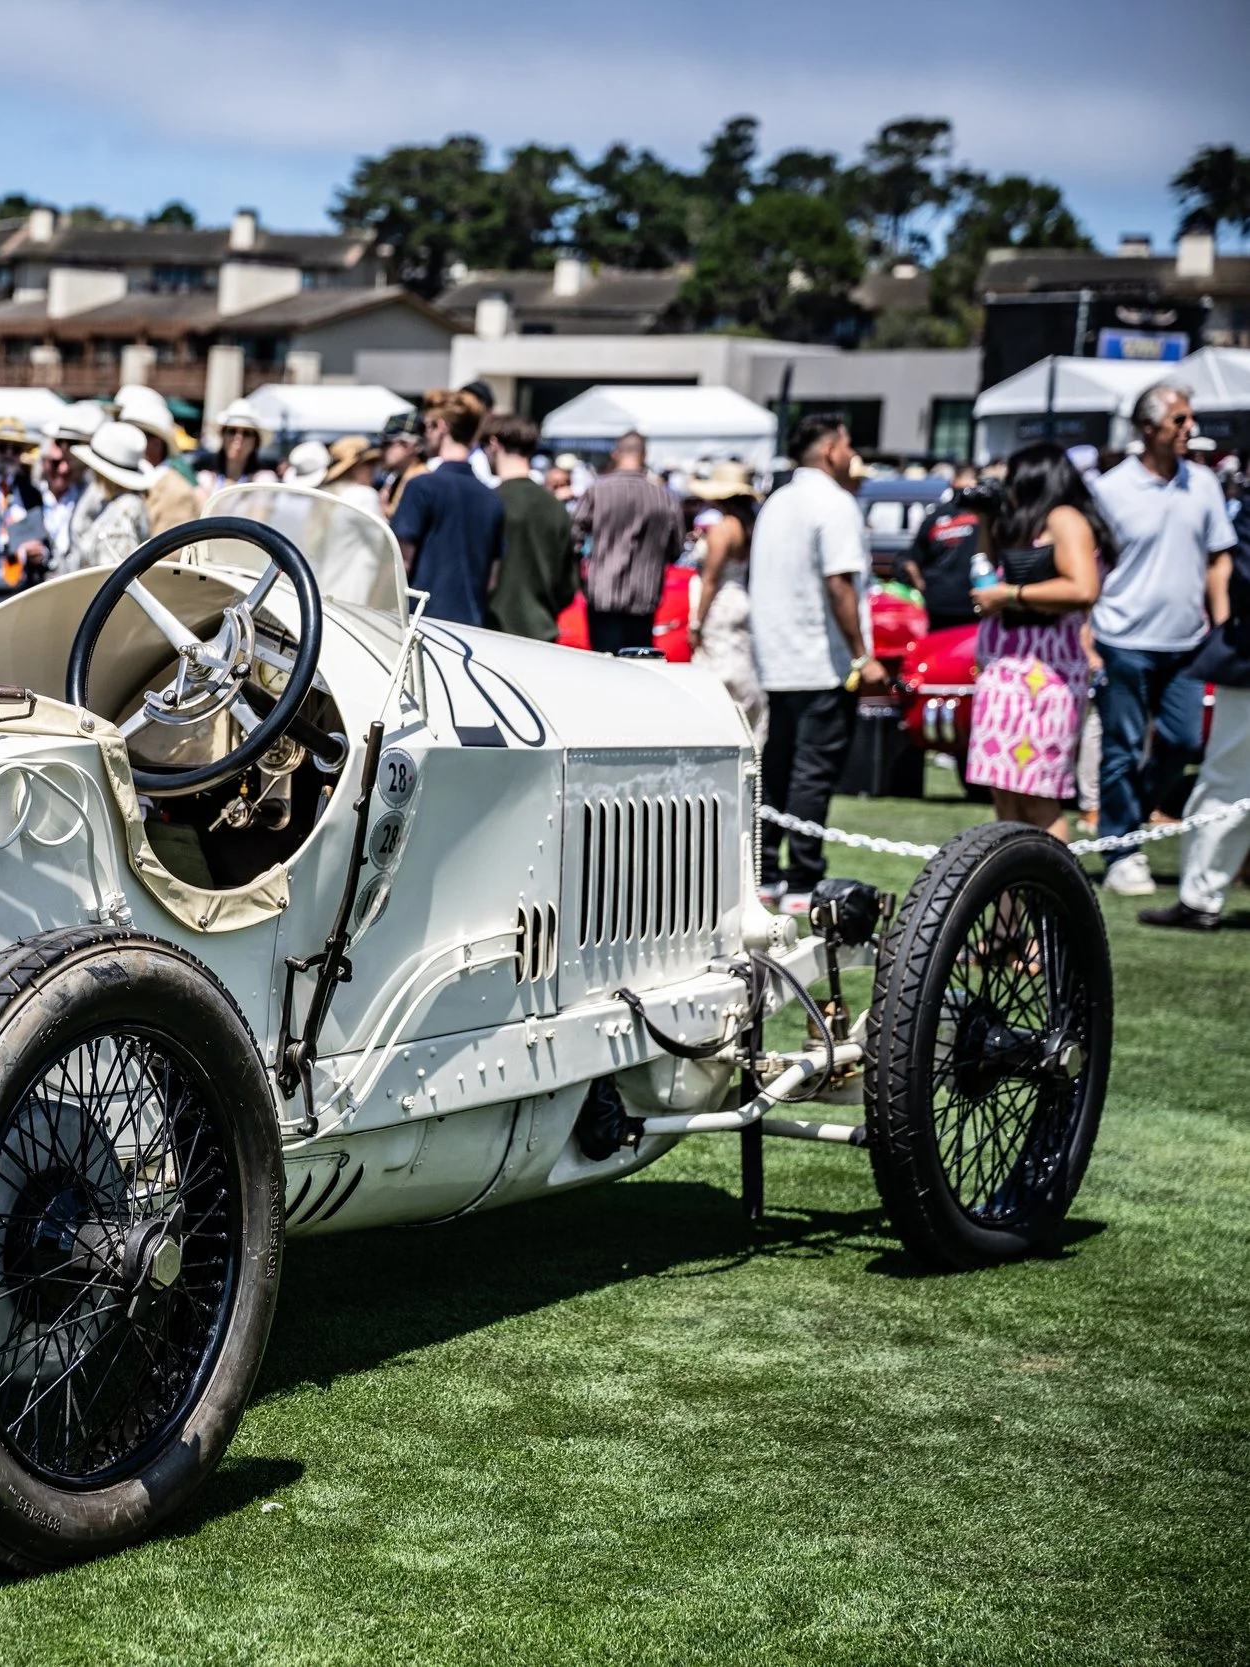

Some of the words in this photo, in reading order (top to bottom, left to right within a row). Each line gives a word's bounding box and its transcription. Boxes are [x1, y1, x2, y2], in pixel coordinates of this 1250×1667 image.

[388, 762, 407, 794] 28
[378, 823, 399, 854] 28
[265, 1180, 280, 1279] EXCELSIOR
